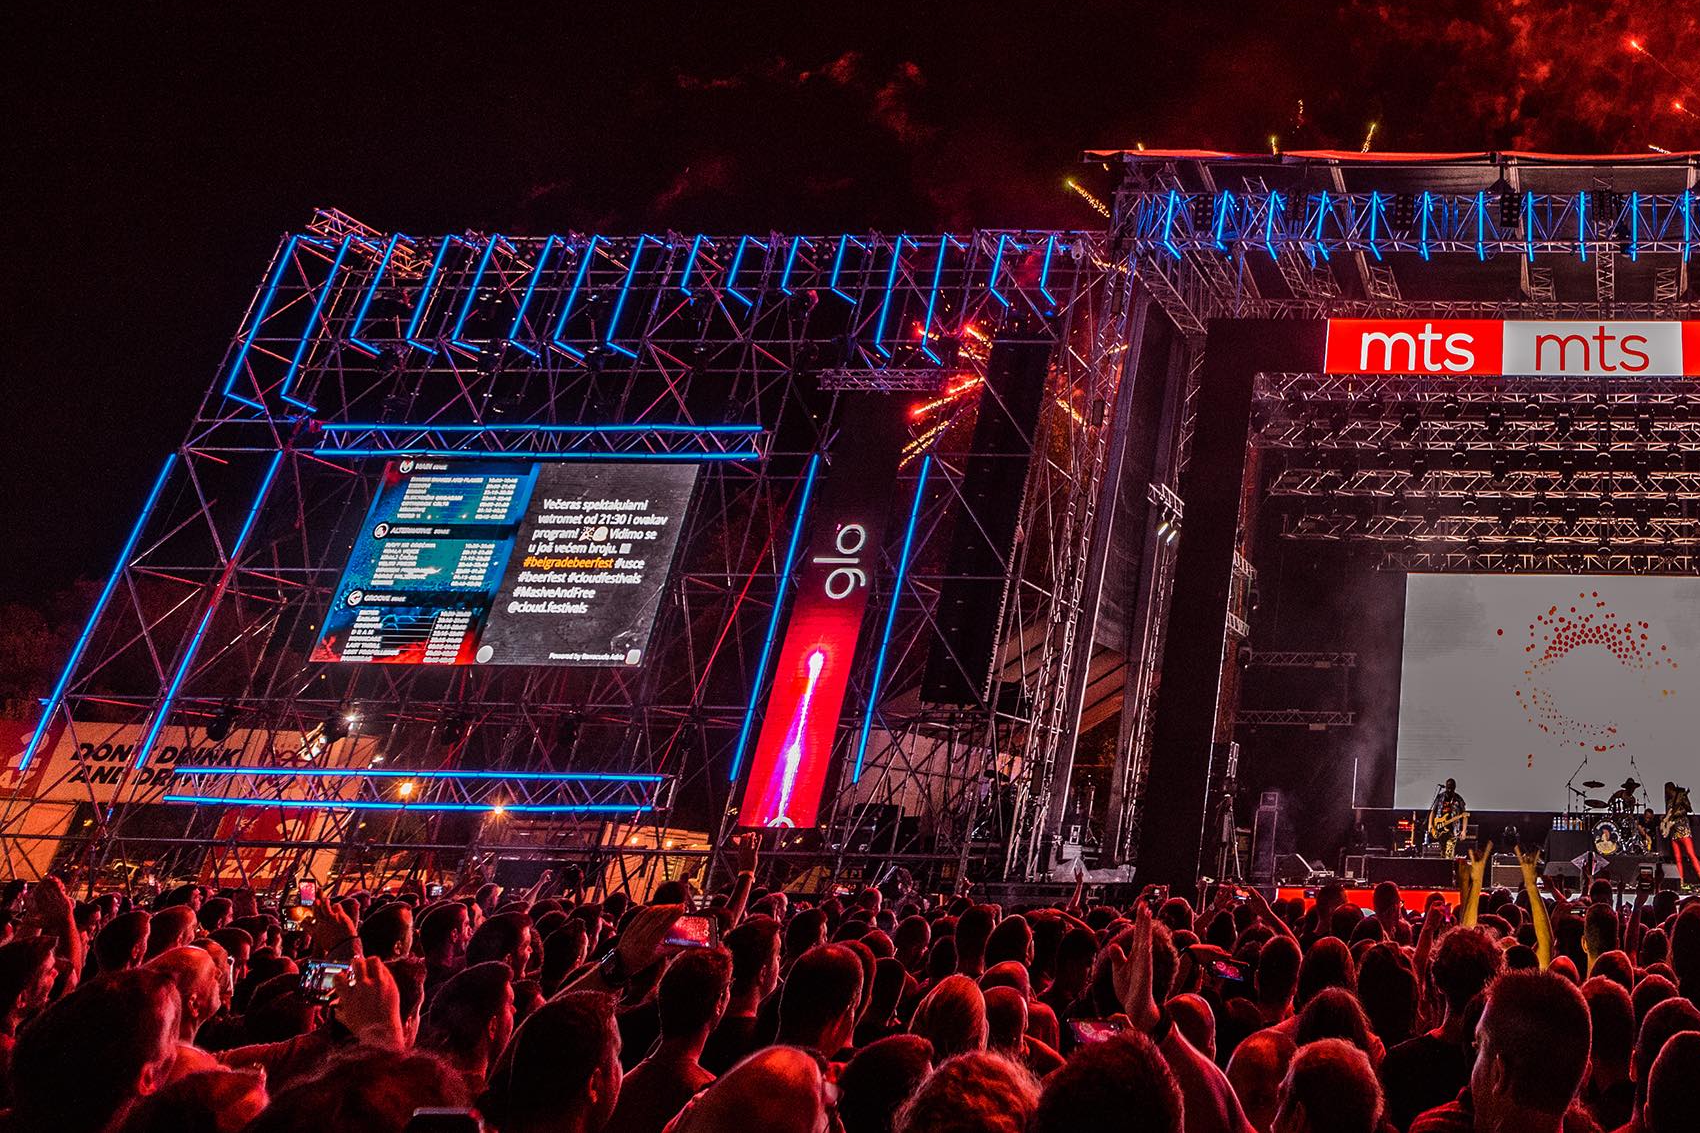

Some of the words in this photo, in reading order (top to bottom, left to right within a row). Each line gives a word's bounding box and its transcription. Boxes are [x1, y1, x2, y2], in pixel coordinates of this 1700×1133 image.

[1360, 323, 1475, 372] mts
[1534, 325, 1650, 372] mts
[543, 499, 582, 510] Večeras
[582, 499, 649, 513] spektakularni
[538, 514, 583, 525] vatromet
[584, 514, 598, 525] od
[599, 514, 626, 525] 21:30
[632, 514, 668, 525] ovakav
[610, 528, 644, 540] Vidimo
[645, 530, 657, 540] se
[528, 544, 536, 554] u
[536, 543, 553, 555] još
[523, 557, 614, 570] #belgradebeerfest
[518, 572, 567, 584] #beerfest
[568, 572, 642, 584] #cloudfestivals
[507, 602, 588, 614] @cloud.festivals
